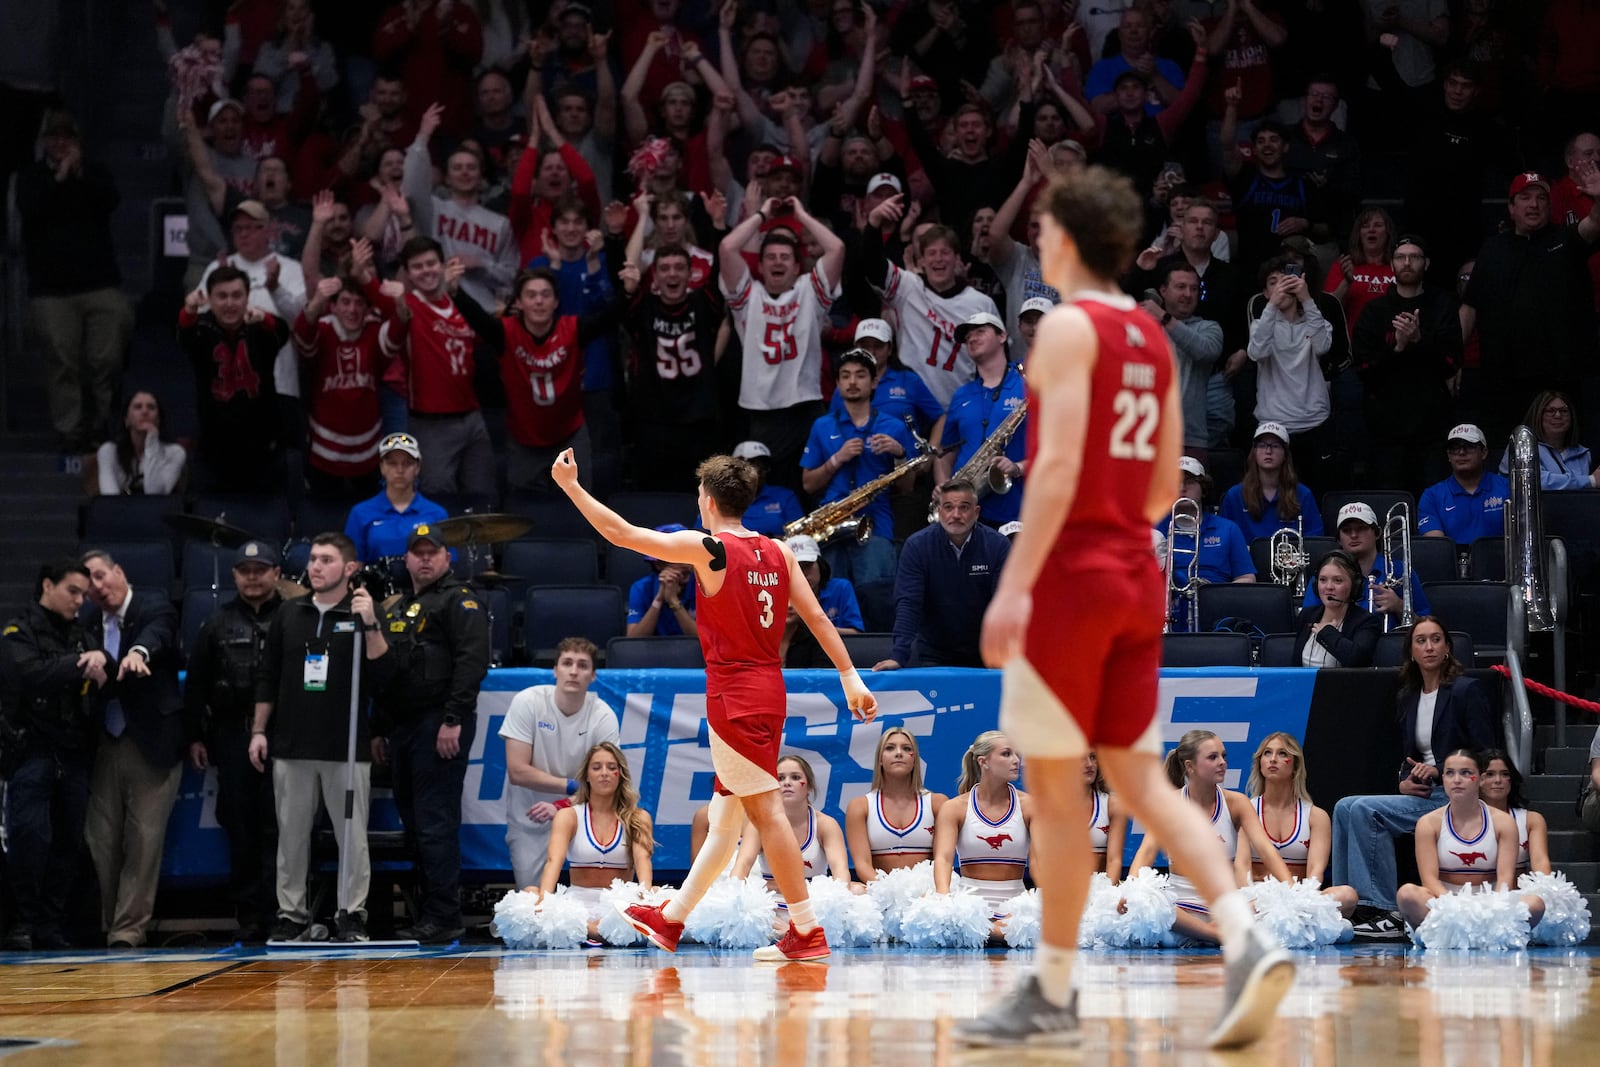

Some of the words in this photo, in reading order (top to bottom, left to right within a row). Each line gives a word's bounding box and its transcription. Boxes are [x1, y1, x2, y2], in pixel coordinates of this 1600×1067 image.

[656, 331, 702, 380] 55
[529, 371, 556, 406] 0
[1109, 388, 1161, 462] 22
[757, 589, 774, 629] 3
[538, 721, 556, 731] SMU
